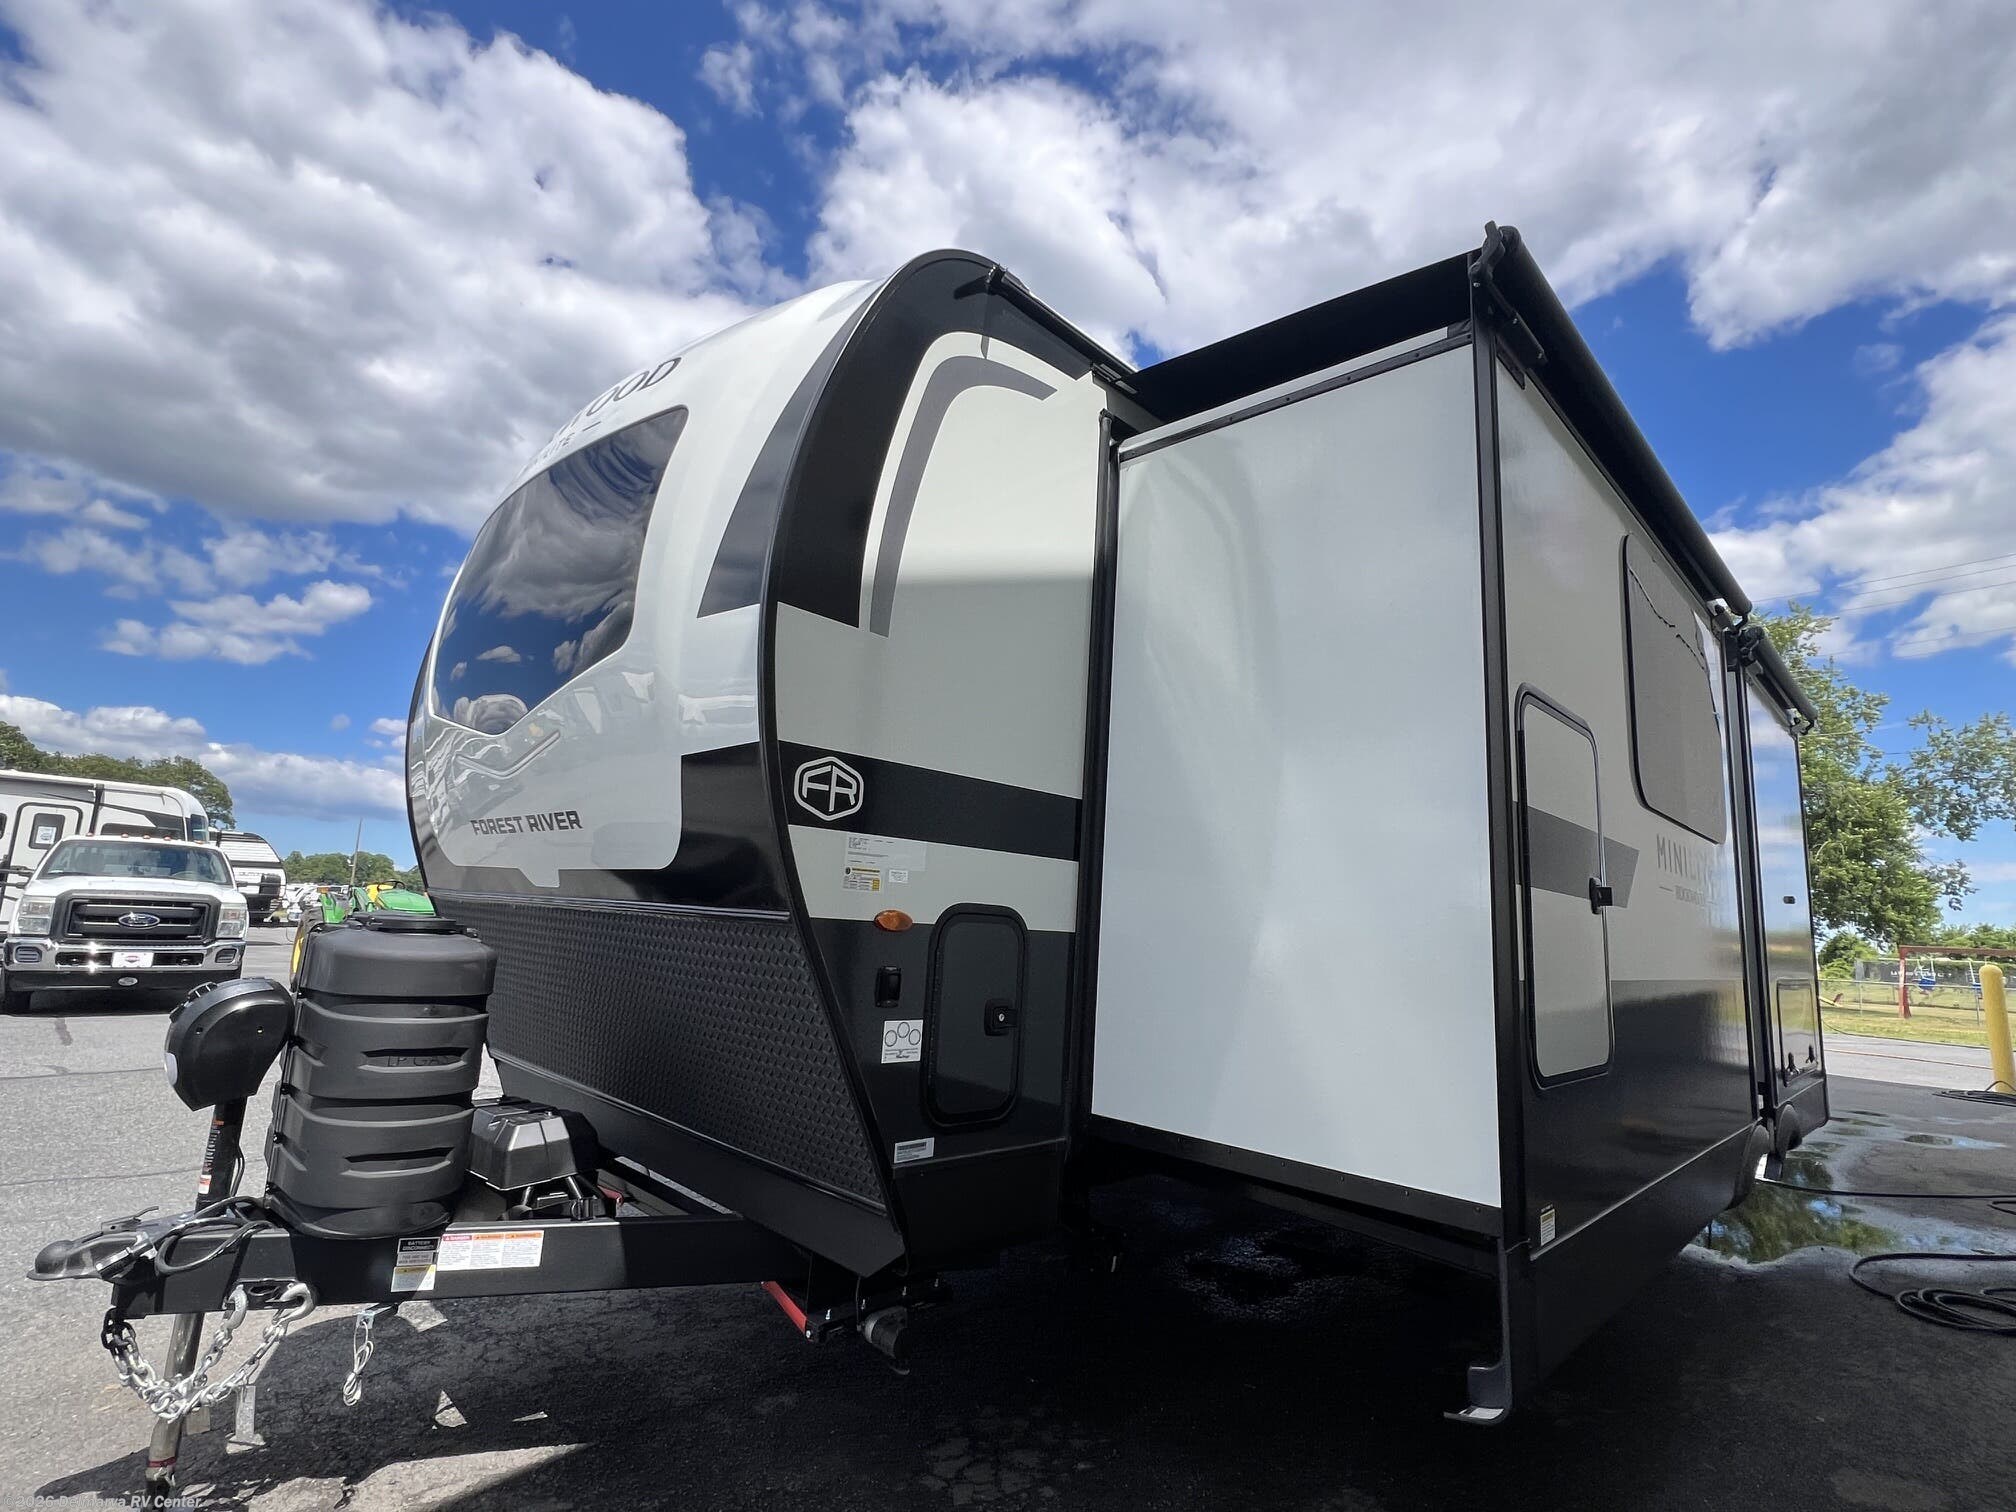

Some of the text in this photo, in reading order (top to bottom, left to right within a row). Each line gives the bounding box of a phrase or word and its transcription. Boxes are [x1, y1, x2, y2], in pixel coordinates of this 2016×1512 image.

[470, 810, 583, 835] FOREST RIVER
[1656, 833, 1688, 878] MINI
